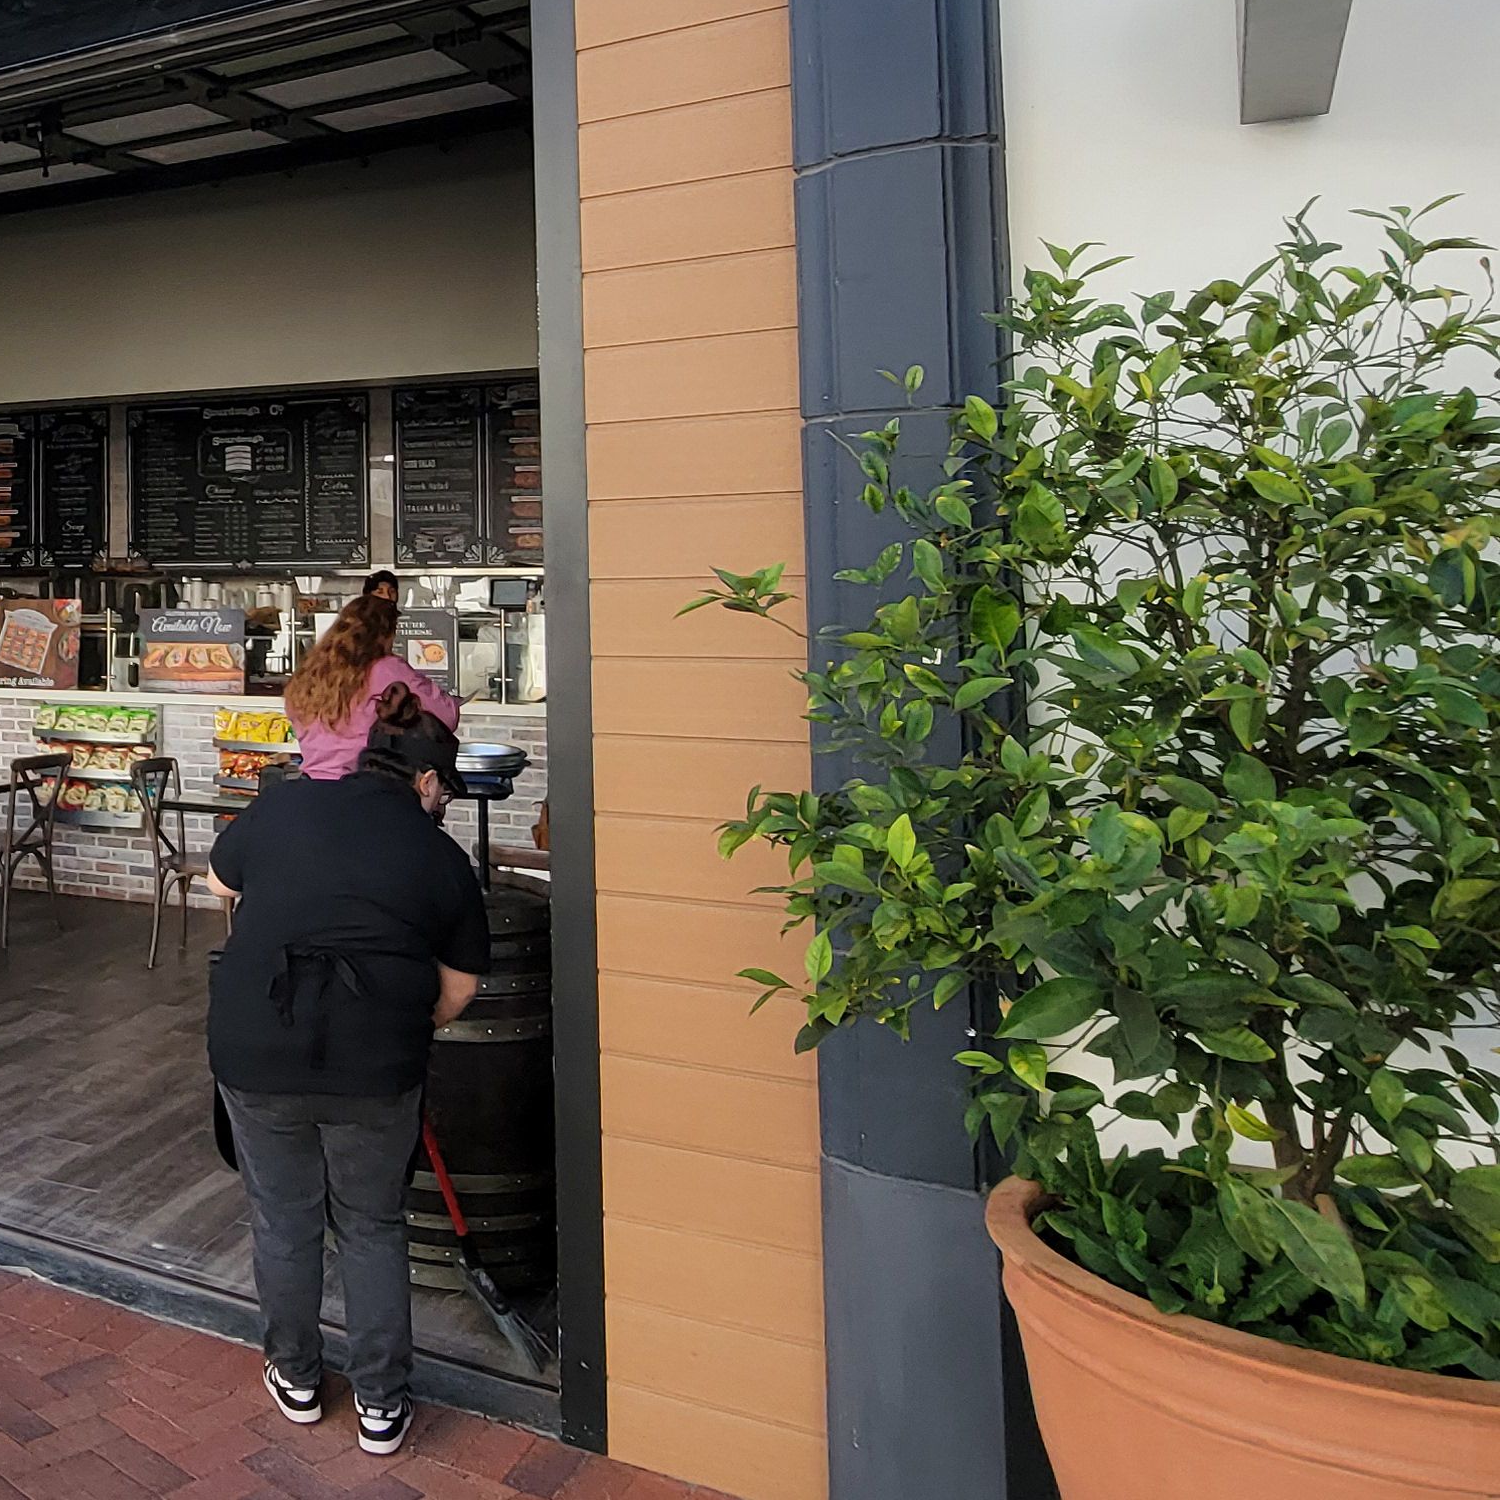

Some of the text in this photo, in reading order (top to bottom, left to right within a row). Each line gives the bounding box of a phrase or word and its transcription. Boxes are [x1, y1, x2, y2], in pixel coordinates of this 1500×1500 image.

[151, 616, 232, 635] Available Now
[18, 676, 54, 687] Available
